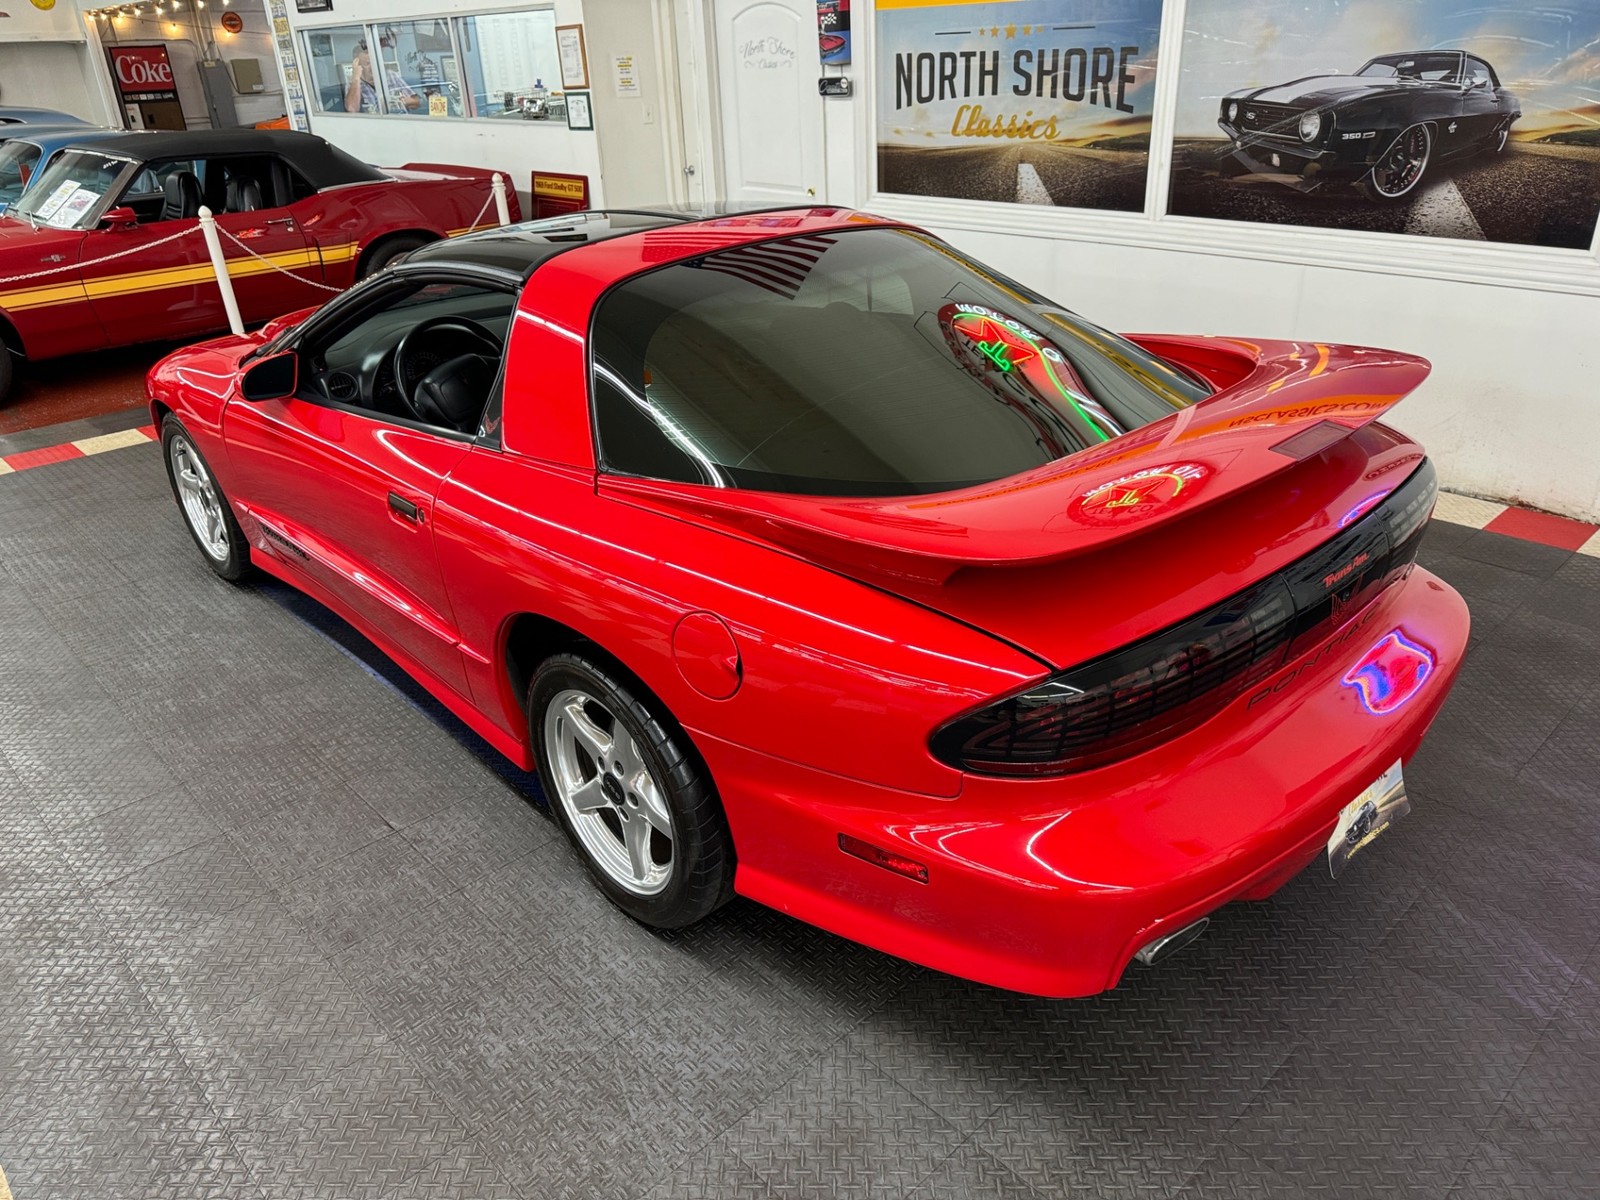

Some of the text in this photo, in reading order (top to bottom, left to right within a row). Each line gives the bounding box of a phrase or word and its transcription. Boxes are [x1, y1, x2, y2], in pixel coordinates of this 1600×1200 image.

[115, 55, 173, 84] Coke
[896, 46, 1139, 114] NORTH SHORE
[951, 104, 1061, 140] Classics
[1341, 132, 1361, 140] 350
[1247, 602, 1381, 710] PONTIAC
